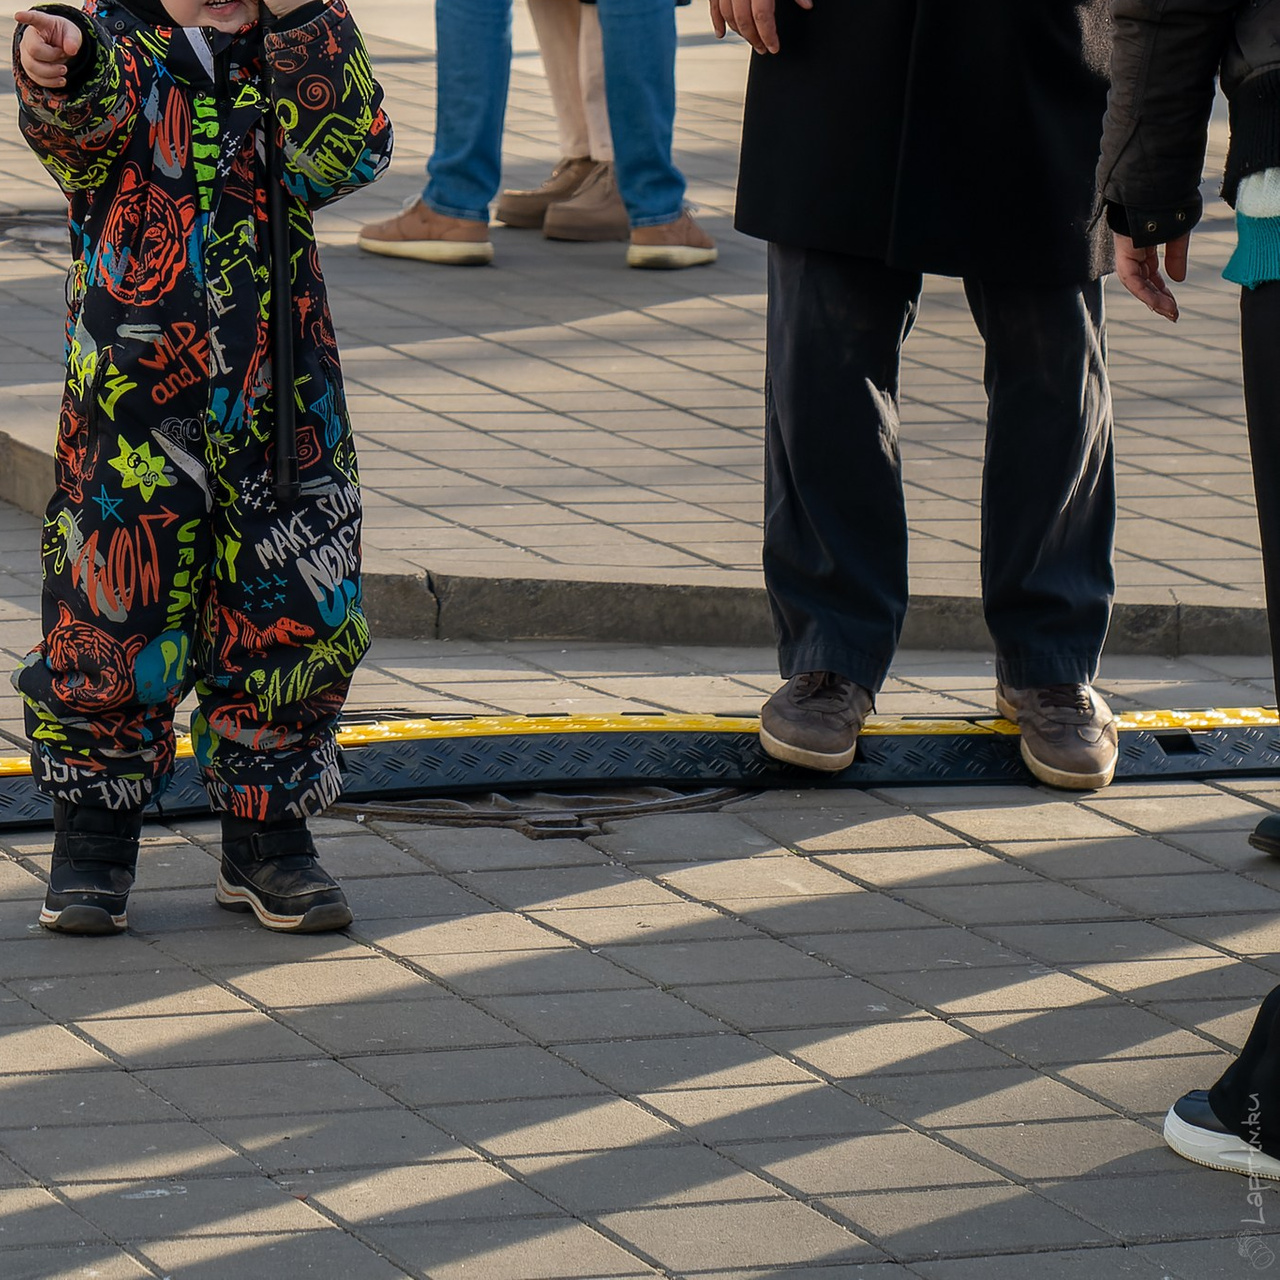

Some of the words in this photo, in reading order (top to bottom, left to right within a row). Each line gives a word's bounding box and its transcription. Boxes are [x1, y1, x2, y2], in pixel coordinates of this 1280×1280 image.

[151, 354, 202, 405] and
[72, 522, 163, 618] WOW
[254, 508, 325, 570] MAKE
[316, 482, 361, 530] SOM
